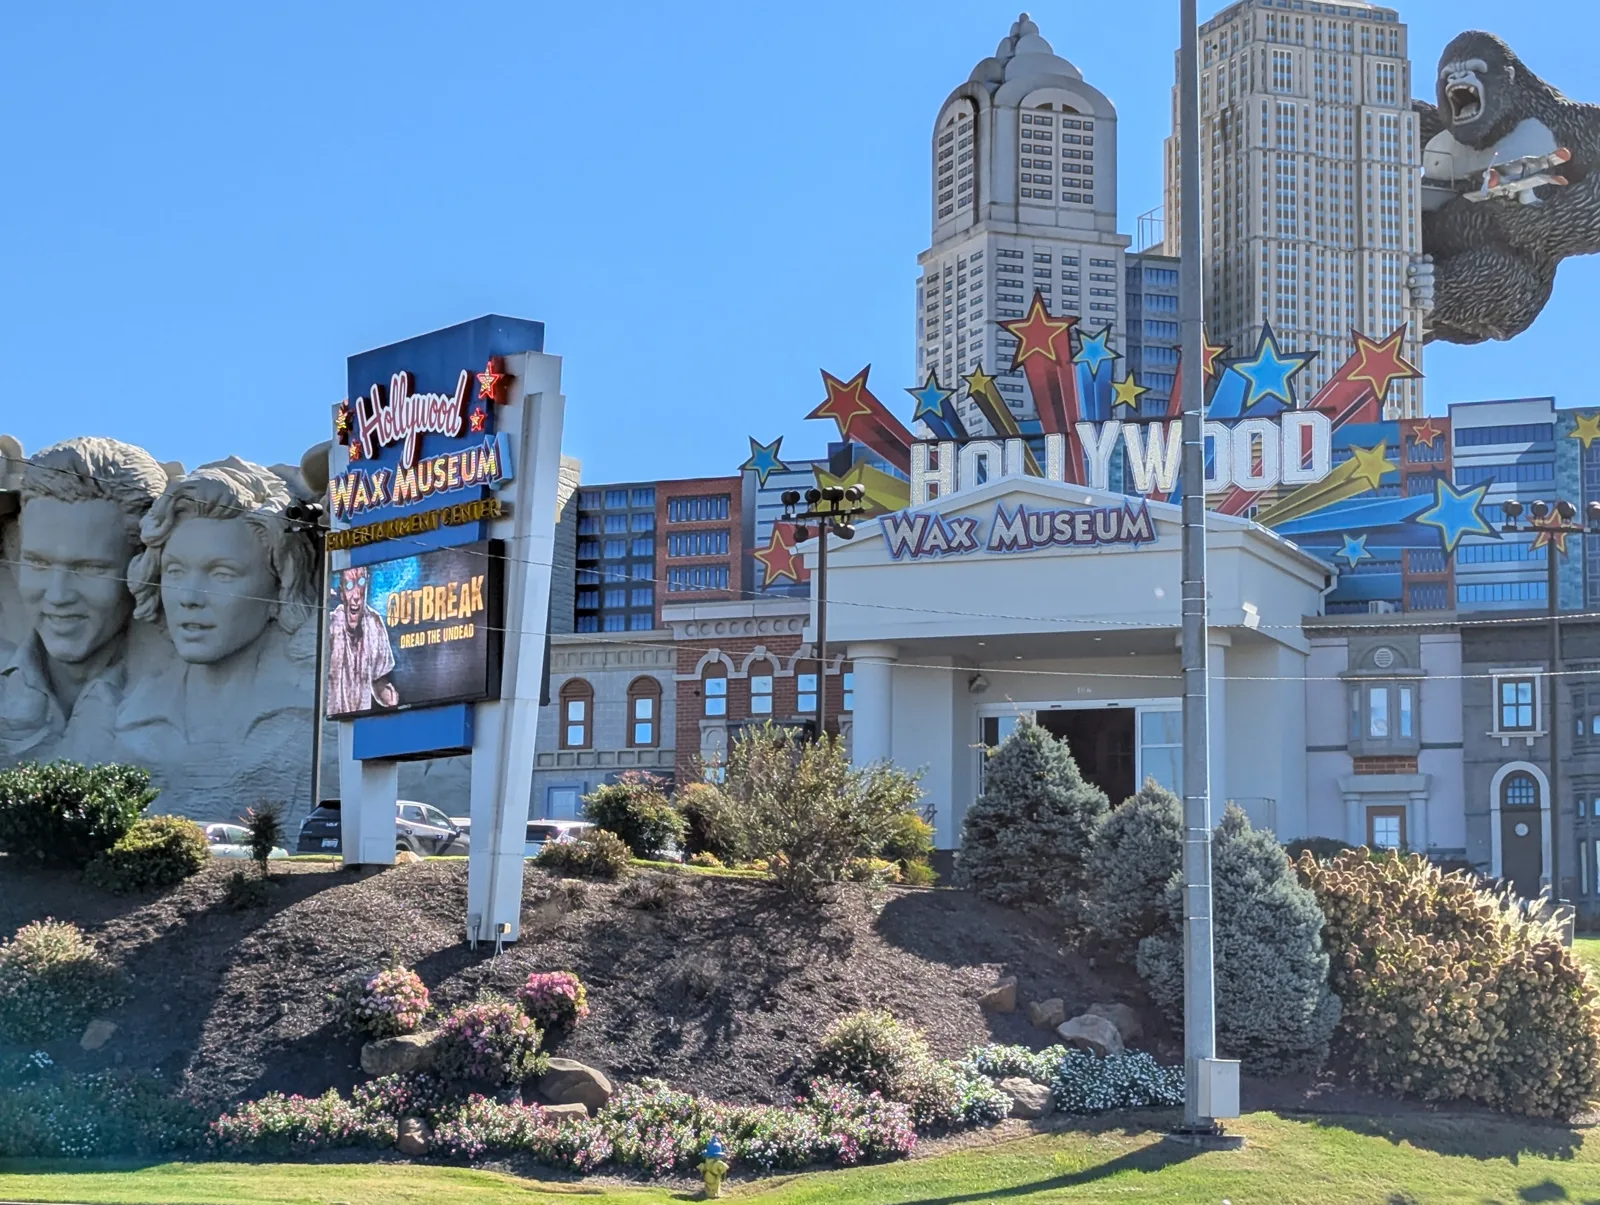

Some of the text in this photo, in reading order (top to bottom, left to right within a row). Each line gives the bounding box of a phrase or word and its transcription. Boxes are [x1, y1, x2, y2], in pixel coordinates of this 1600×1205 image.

[355, 369, 468, 468] Hollywood
[330, 443, 500, 516] WAX MUSEUM
[326, 497, 502, 551] ENTERTAINMENT CENTER
[880, 502, 1155, 558] WAX MUSEUM
[386, 575, 484, 627] OUTBREAK
[400, 623, 475, 649] DREAD THE UNDEAD
